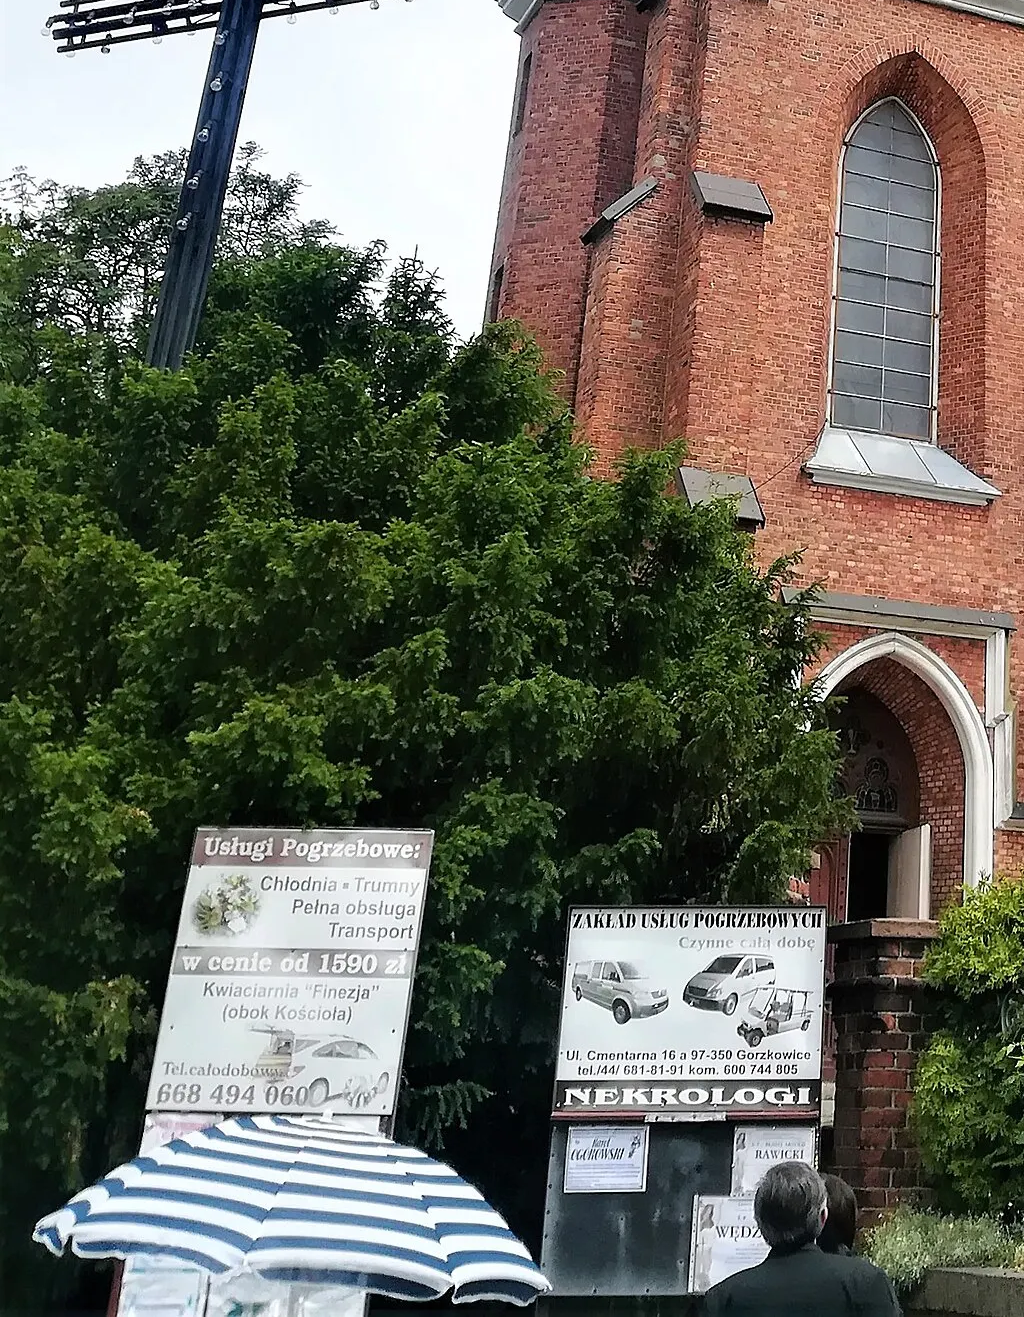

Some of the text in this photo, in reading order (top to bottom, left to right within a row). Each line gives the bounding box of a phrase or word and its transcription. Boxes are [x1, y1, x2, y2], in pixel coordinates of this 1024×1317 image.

[204, 837, 422, 863] Usługi Pogrzebowe:
[260, 876, 421, 897] Chłodnia Trumny
[292, 899, 416, 920] Pełna obsługa
[572, 911, 822, 930] ZAKŁAD USŁUG POGRZEBOWYCH
[329, 922, 414, 942] Transport
[678, 936, 816, 951] Czynne całą dobę
[182, 951, 406, 975] w cenie od 1590 zł
[202, 981, 299, 999] Kwiaciarnia
[222, 1005, 353, 1025] (obok Kościoła)
[566, 1049, 811, 1061] Ul. Cmentarna 16 a 97-350 Gorzkowice
[578, 1064, 798, 1076] tel./44/ 681-81-91 kom. 600 744 805
[157, 1083, 201, 1105] 668
[209, 1085, 256, 1106] 494
[563, 1087, 811, 1107] NEKROLOGI
[755, 1149, 804, 1159] RAWICKI
